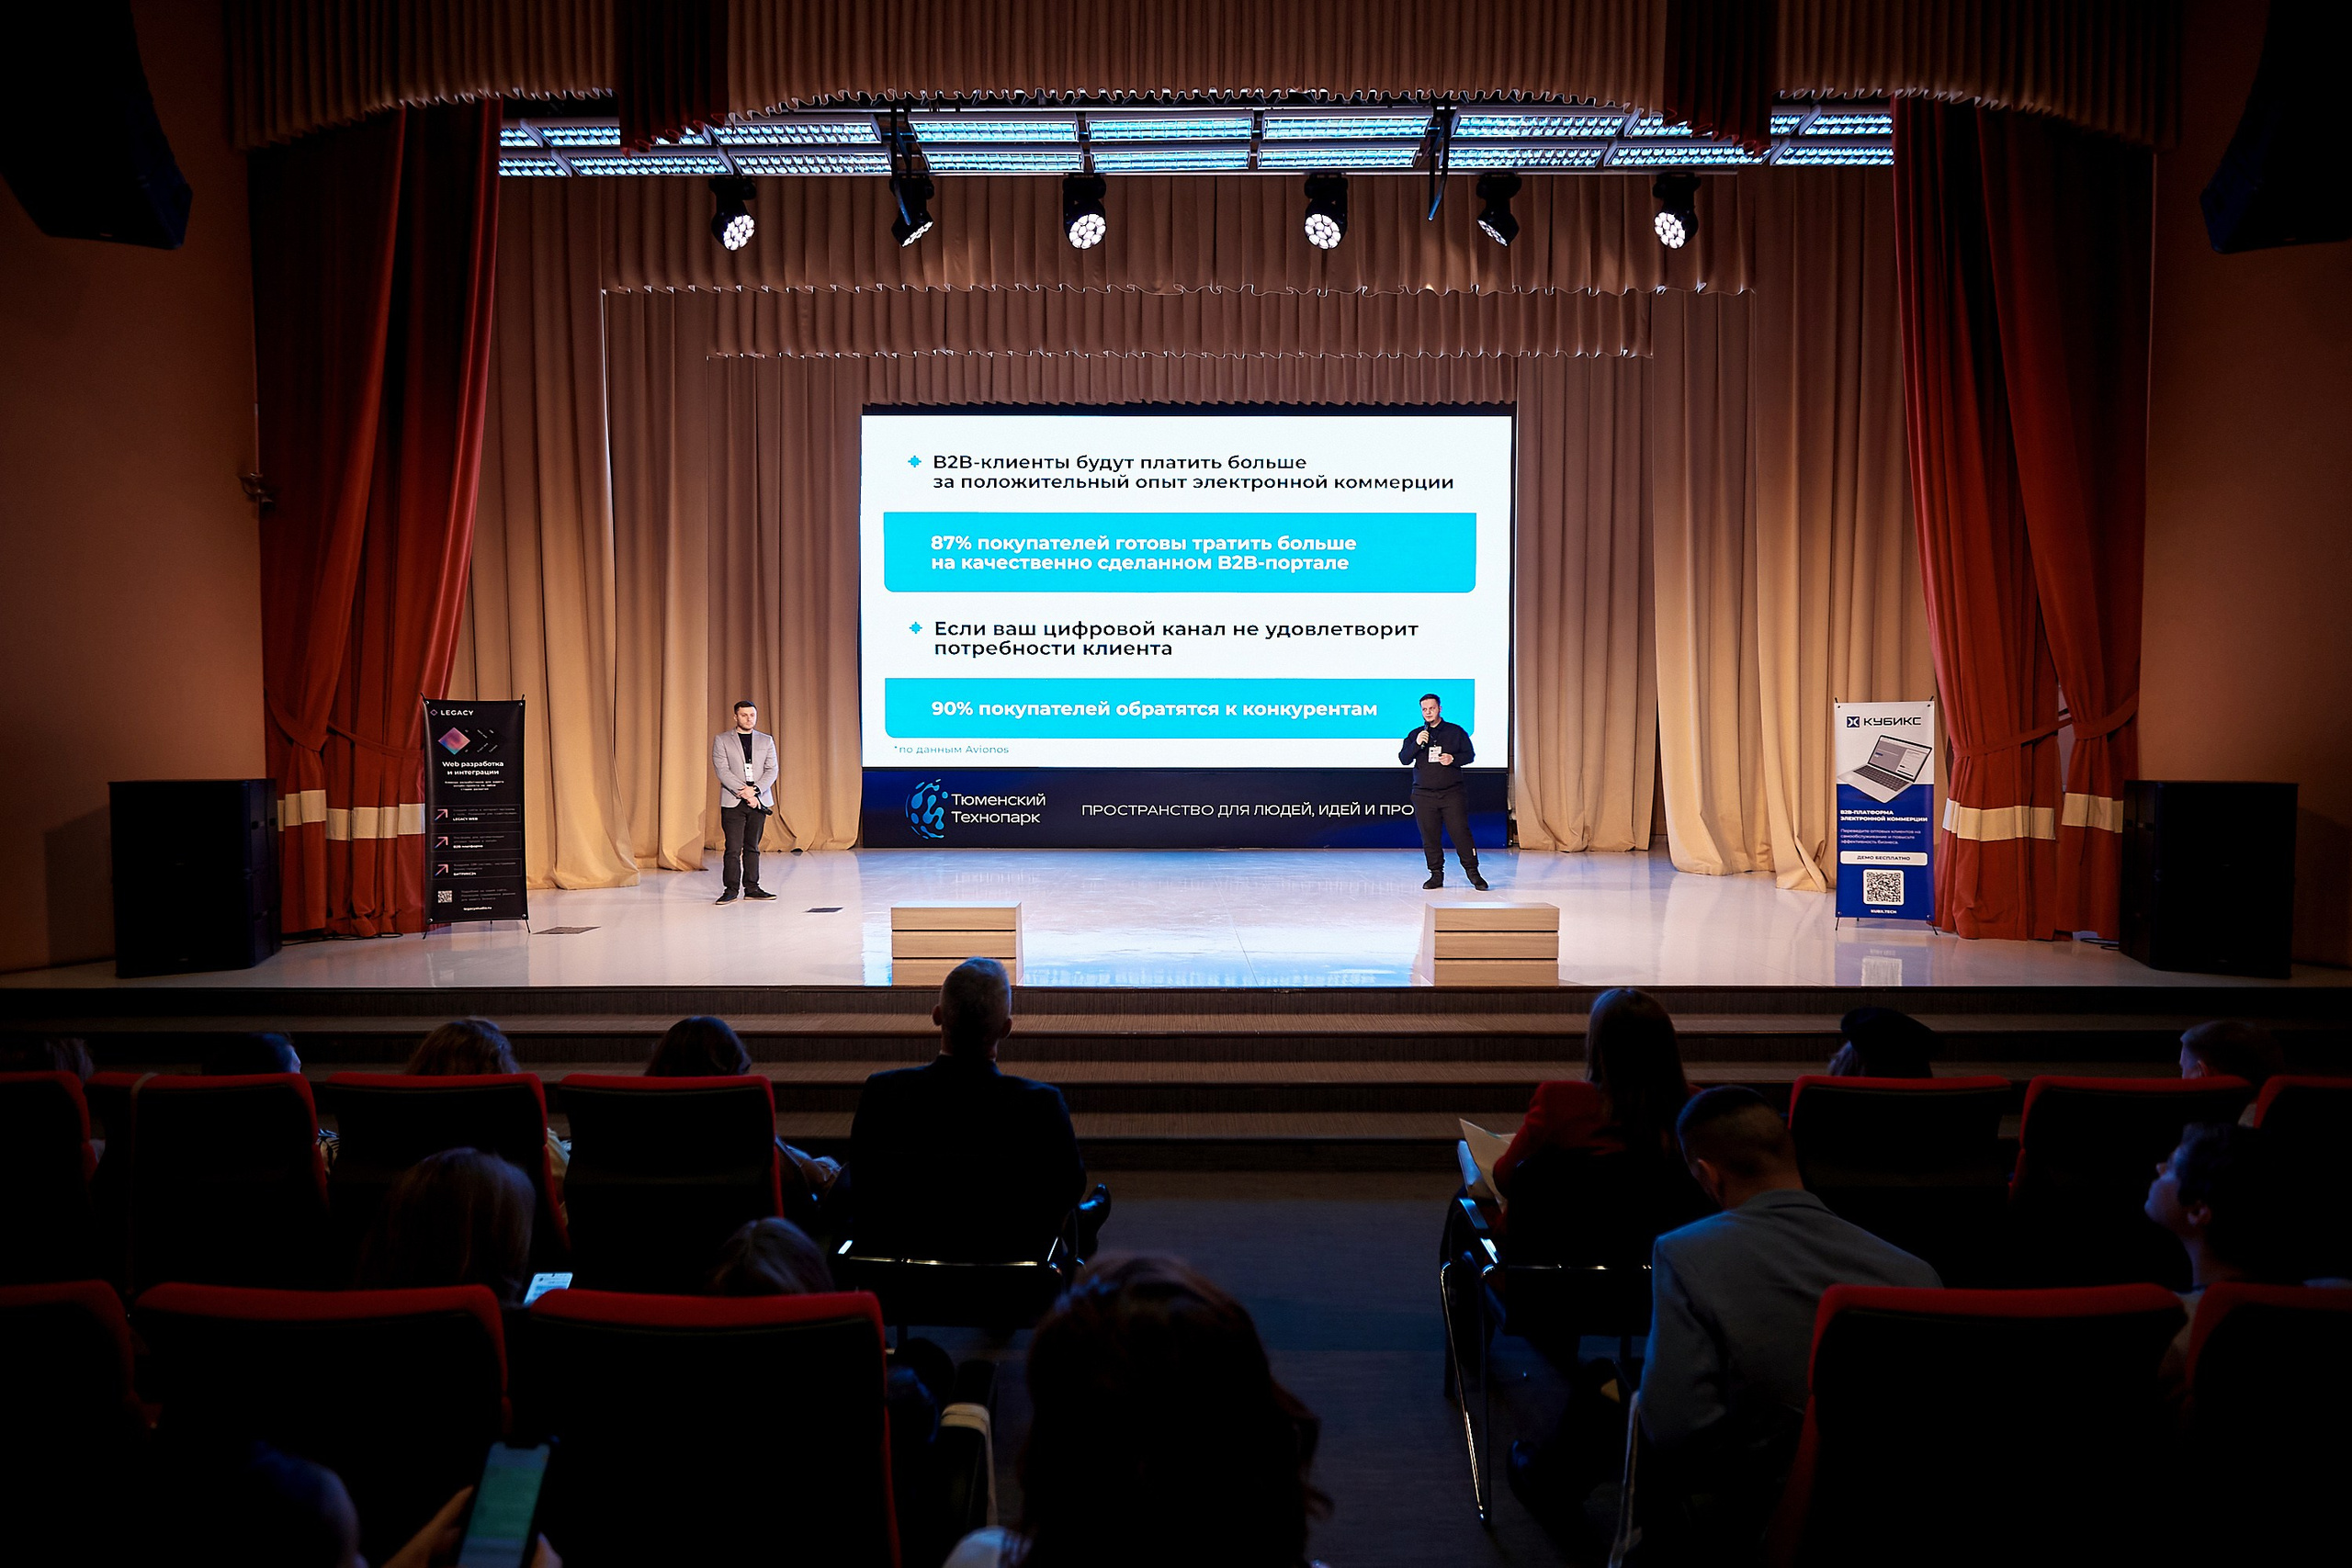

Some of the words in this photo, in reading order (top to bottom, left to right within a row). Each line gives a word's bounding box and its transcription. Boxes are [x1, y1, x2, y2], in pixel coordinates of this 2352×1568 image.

[933, 456, 1069, 469] B2B-клиенты
[1076, 454, 1135, 472] будут
[1140, 458, 1222, 469] платить
[1227, 455, 1306, 469] больше
[933, 478, 955, 489] за
[961, 474, 1129, 489] положительный
[1135, 478, 1188, 489] опыт
[1193, 474, 1328, 492] электронной
[1334, 478, 1453, 492] коммерции
[931, 535, 972, 551] 87%
[978, 535, 1110, 554] покупателей
[1115, 538, 1187, 551] готовы
[1192, 538, 1272, 554] тратить
[1277, 535, 1358, 551] больше
[931, 557, 956, 570] на
[960, 557, 1092, 570] качественно
[1098, 557, 1213, 572] сделанном
[1217, 554, 1350, 573] B2B-портале
[934, 621, 986, 636] Если
[993, 625, 1036, 636] ваш
[1044, 620, 1155, 640] цифровой
[1162, 625, 1226, 636] канал
[1234, 625, 1260, 636] не
[1265, 625, 1419, 640] удовлетворит
[934, 640, 1076, 659] потребности
[1082, 645, 1172, 656] клиента
[931, 701, 974, 716] 90%
[978, 700, 1111, 720] покупателей
[1115, 700, 1219, 720] обратятся
[1225, 704, 1238, 716] к
[1242, 703, 1378, 720] конкурентам
[1863, 716, 1922, 727] КУБИКС
[965, 745, 1010, 754] Avionos
[951, 793, 1046, 807] Тюменский
[951, 810, 1041, 826] Технопарк
[1081, 805, 1215, 816] ПРОСТРАНСТВО
[1217, 805, 1250, 818] ДЛЯ
[1253, 801, 1315, 818] ЛЮДЕЙ,
[1318, 801, 1361, 818] ИДЕЙ
[1364, 805, 1375, 816] И
